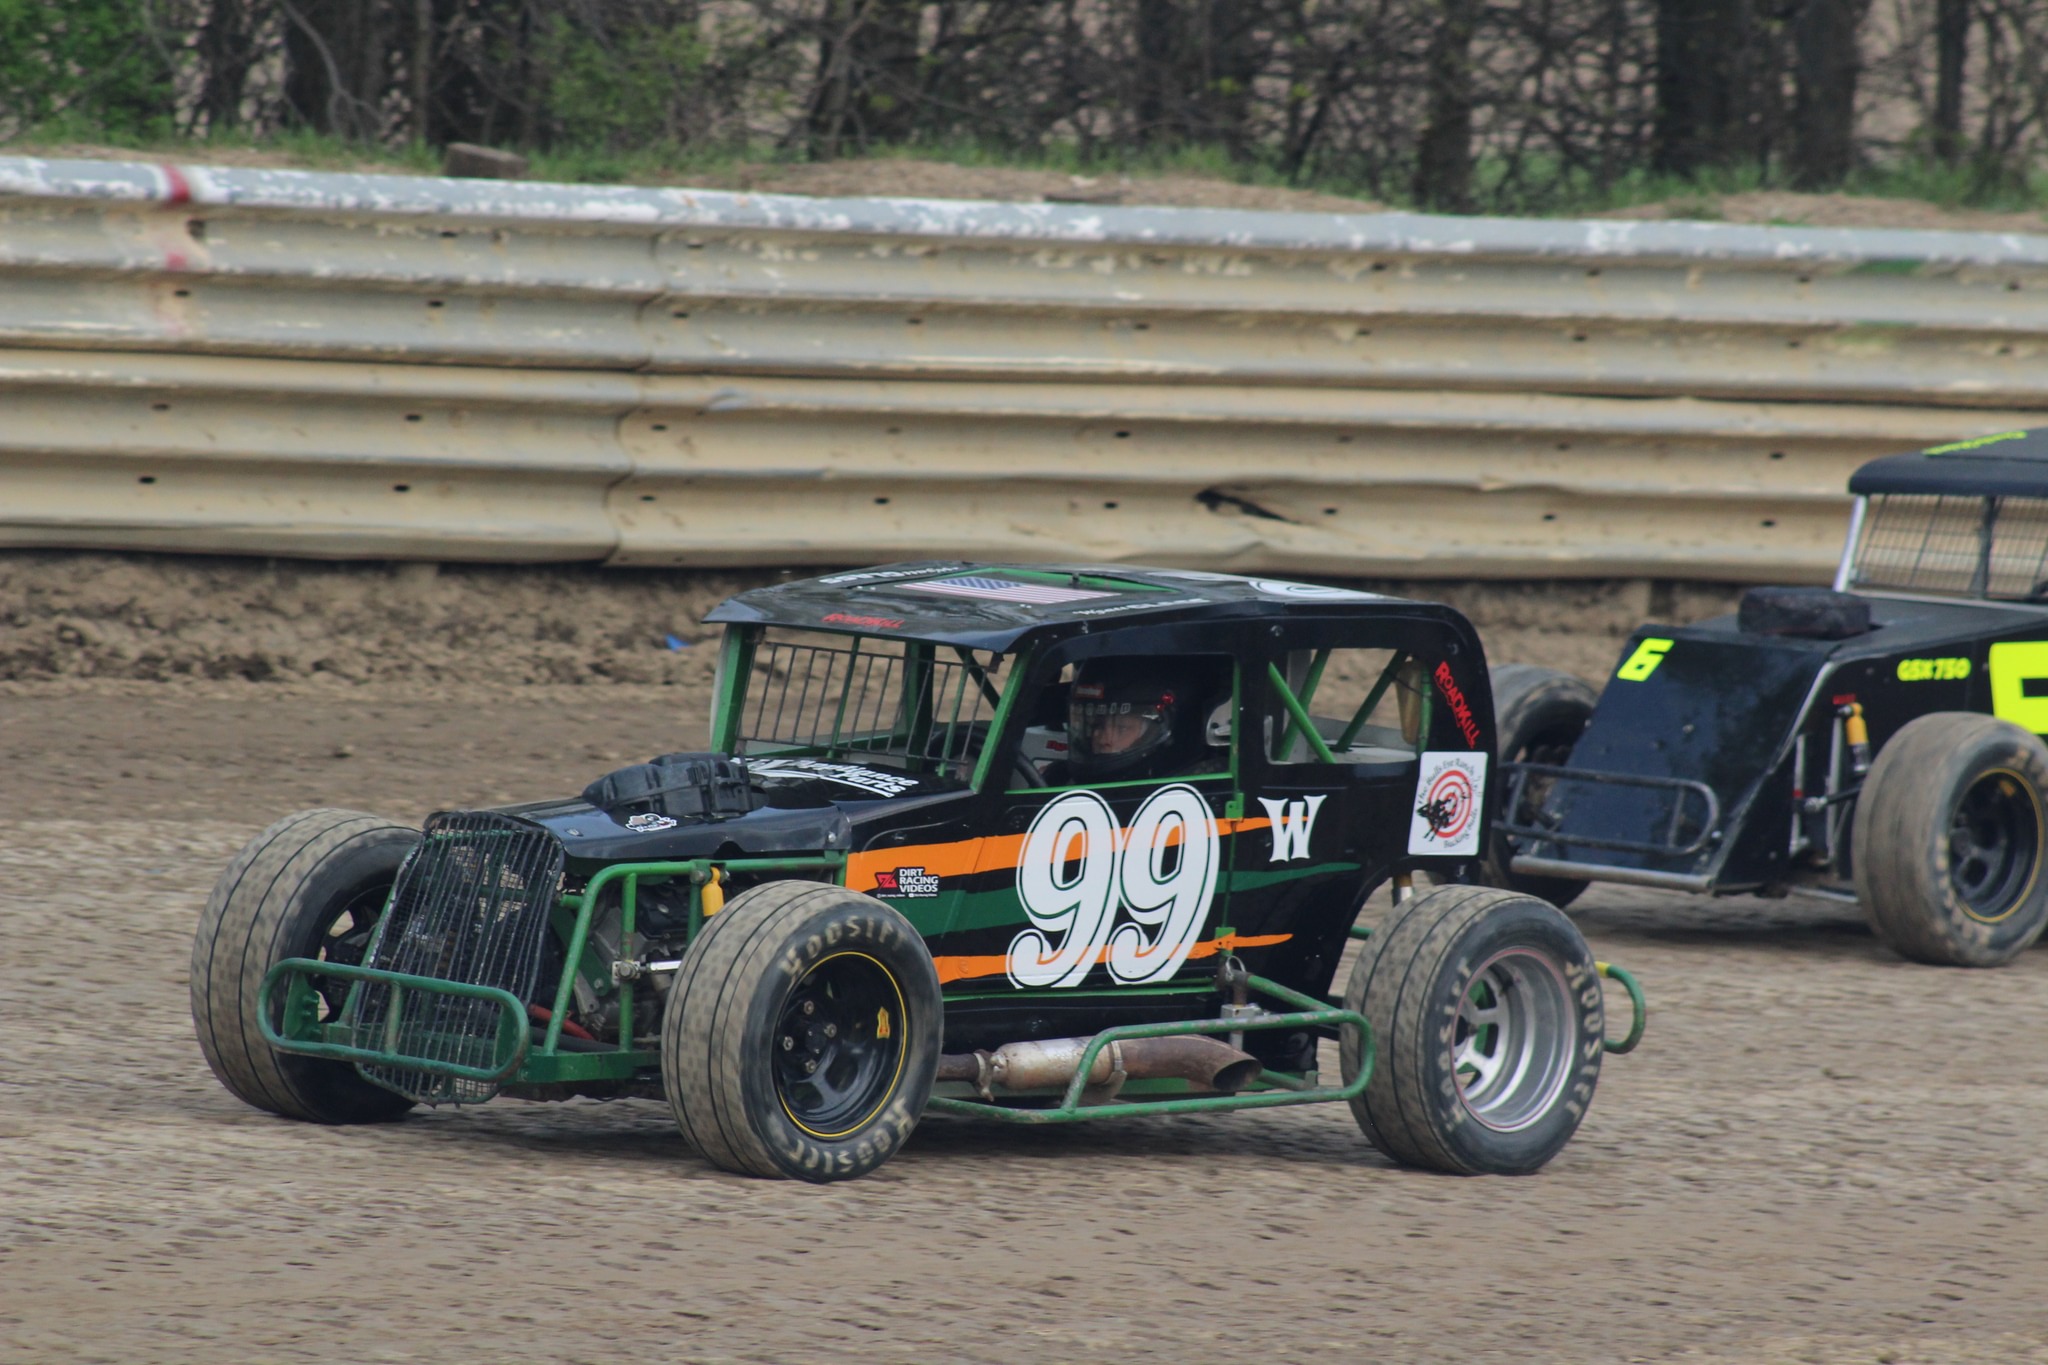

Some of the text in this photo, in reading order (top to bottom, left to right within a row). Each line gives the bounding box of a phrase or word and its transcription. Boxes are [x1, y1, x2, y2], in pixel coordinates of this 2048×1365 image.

[1617, 637, 1675, 682] 6
[1434, 660, 1482, 749] ROADKILL
[831, 772, 907, 793] Parts
[899, 867, 925, 878] DIRT
[899, 876, 939, 885] RACING
[899, 884, 939, 893] VIDEOS
[1006, 783, 1328, 989] 99 W
